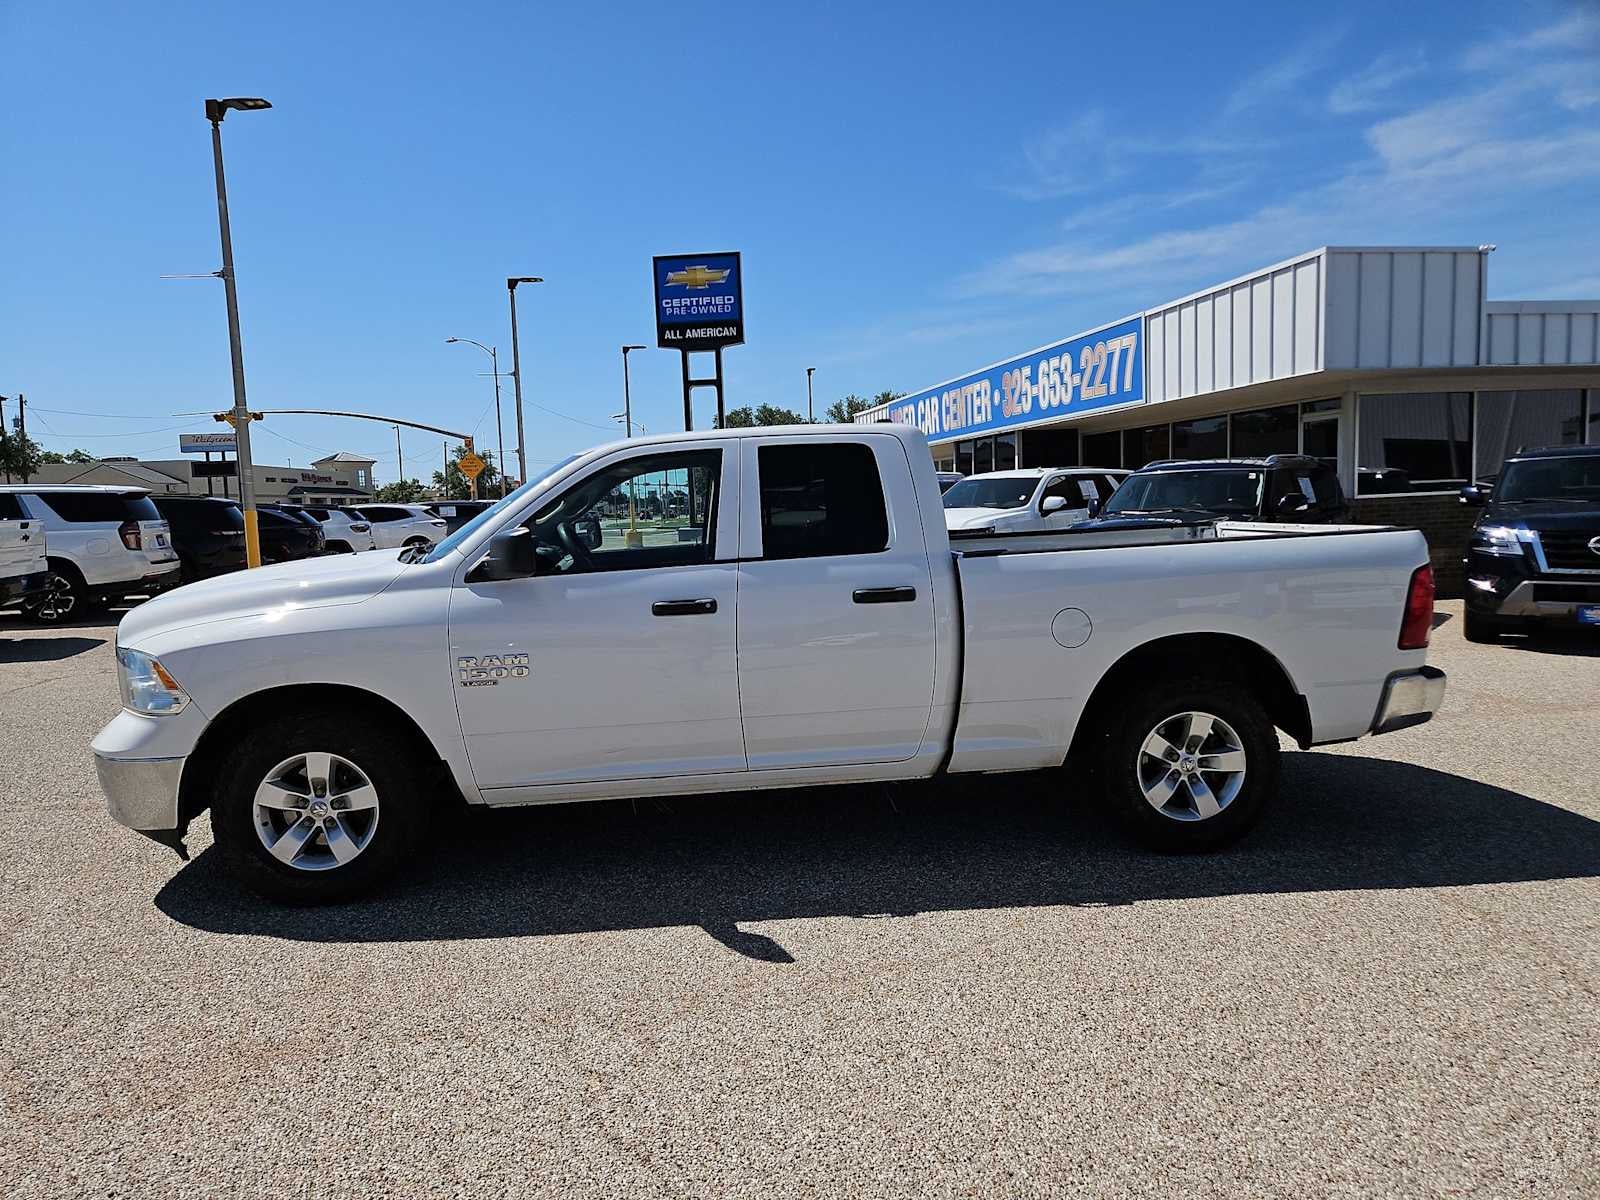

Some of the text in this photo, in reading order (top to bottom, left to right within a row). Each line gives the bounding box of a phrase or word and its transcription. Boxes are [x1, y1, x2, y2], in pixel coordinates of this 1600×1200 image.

[662, 295, 735, 308] CERTIFIED
[666, 304, 732, 316] PRE-OWNED
[664, 326, 737, 340] ALL AMERICAN
[918, 395, 941, 436] CAR
[942, 379, 993, 433] CENTER
[1002, 332, 1138, 418] 325-653-2277
[458, 653, 530, 668] RAM
[458, 666, 530, 681] 1500
